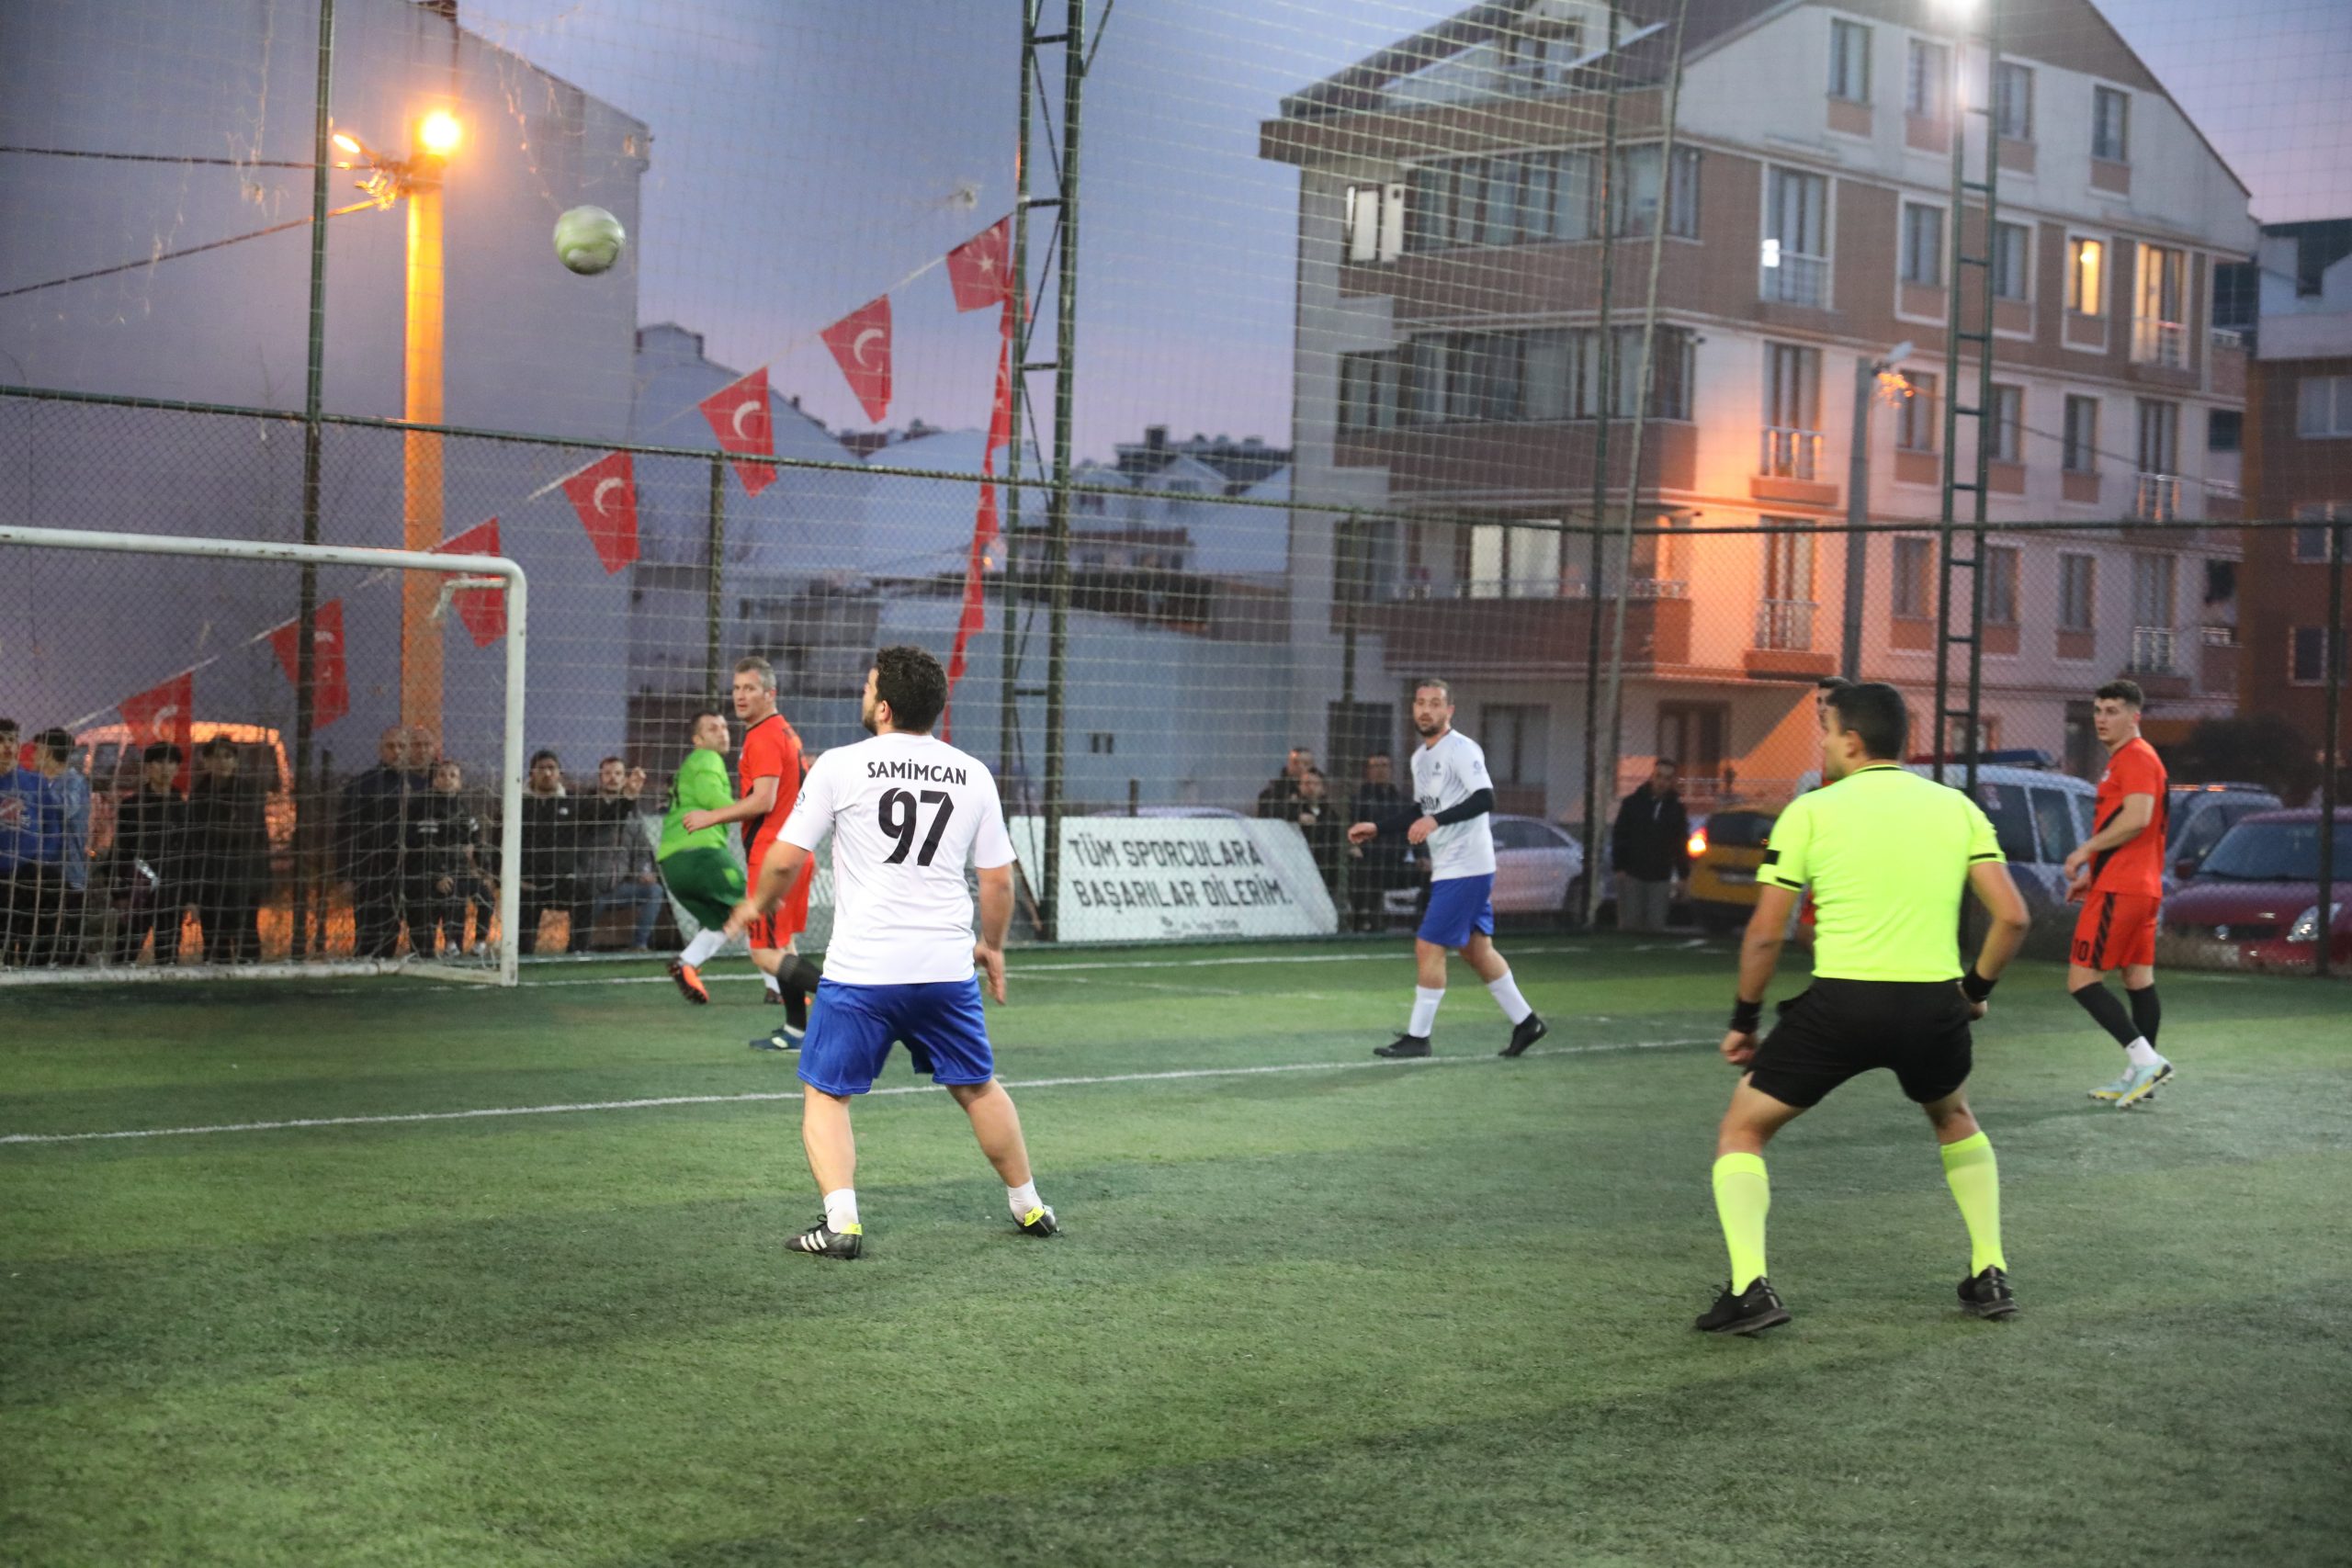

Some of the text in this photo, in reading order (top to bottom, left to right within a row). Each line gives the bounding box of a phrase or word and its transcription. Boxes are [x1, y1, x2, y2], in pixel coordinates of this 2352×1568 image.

[867, 759, 967, 785] SAMİMCAN
[878, 787, 955, 866] 97
[1068, 833, 1264, 867] TÜM SPORCULARA
[1072, 879, 1200, 914] BAŞARILAR
